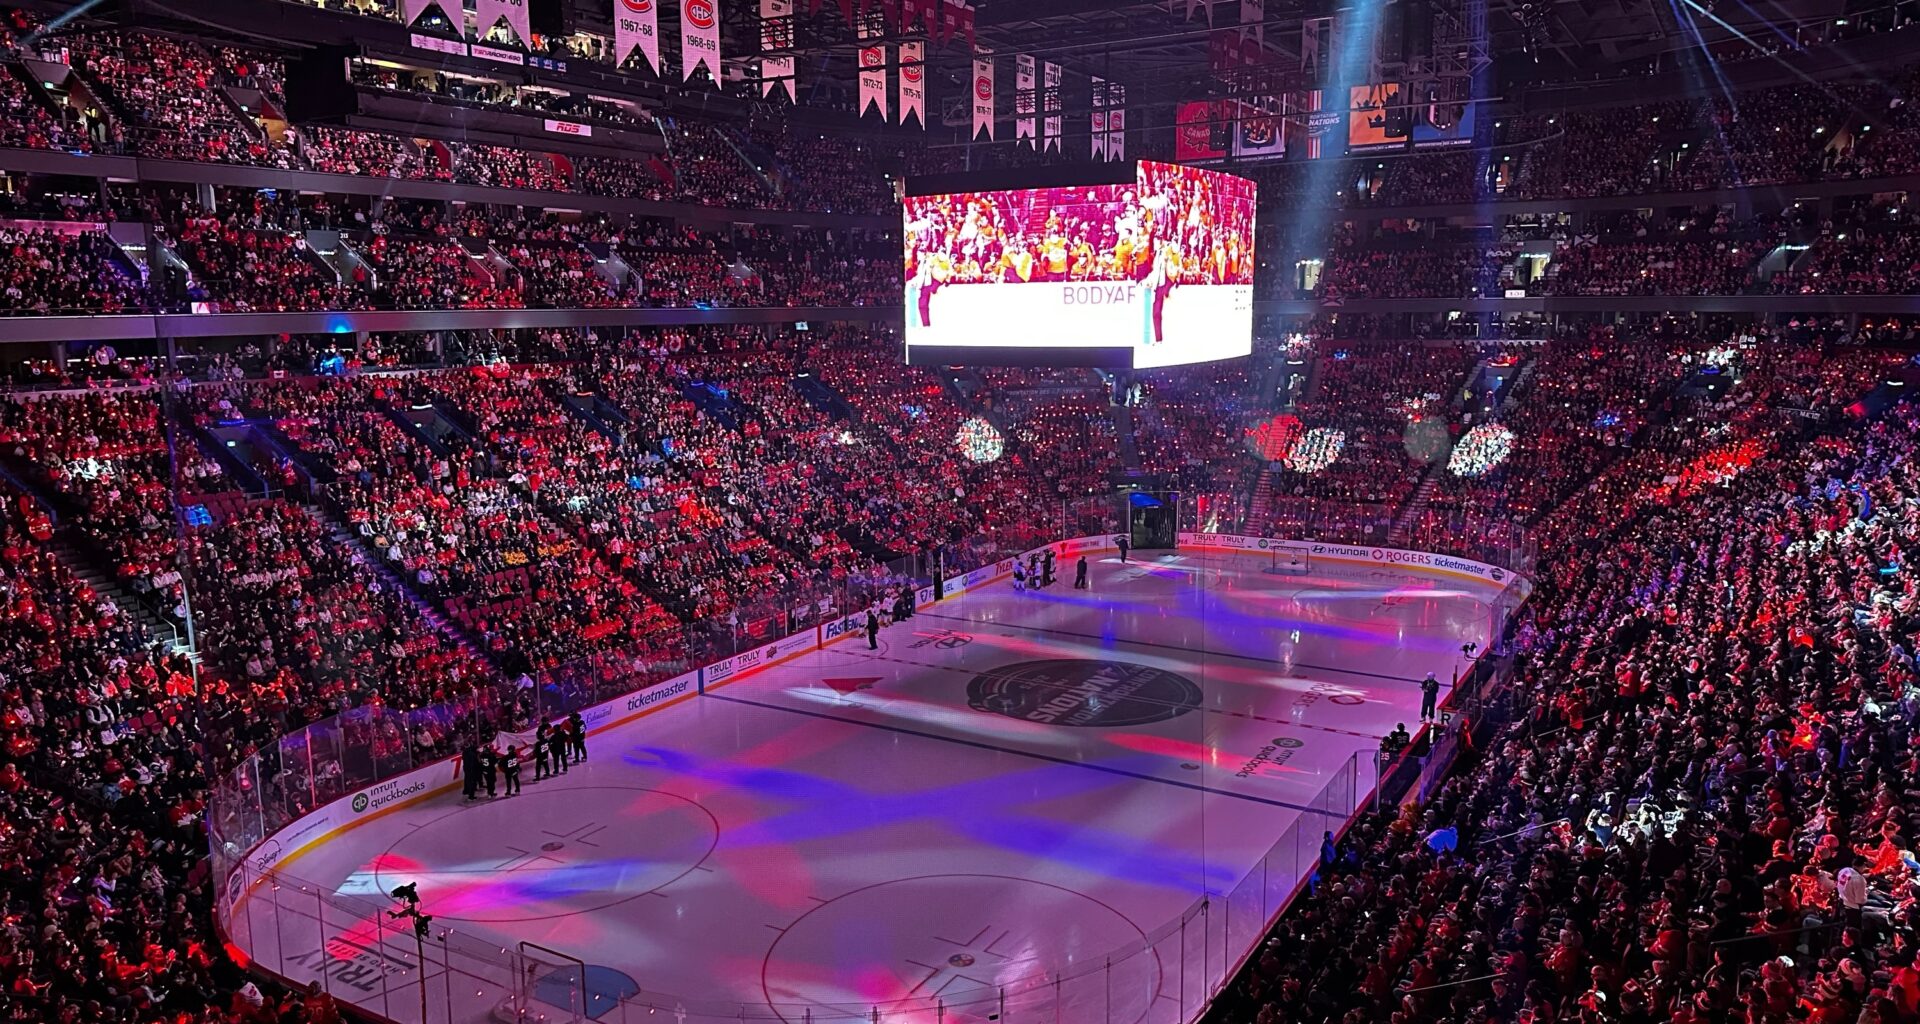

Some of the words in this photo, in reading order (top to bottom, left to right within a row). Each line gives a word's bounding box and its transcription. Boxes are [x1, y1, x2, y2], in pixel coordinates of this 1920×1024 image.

[620, 18, 653, 36] 1967-68
[686, 34, 716, 51] 1968-69
[862, 78, 883, 90] 1972-73
[902, 87, 921, 99] 1975-76
[1308, 116, 1340, 126] NATIONS
[556, 122, 580, 134] RDS
[1187, 127, 1210, 138] CANAD
[1193, 534, 1217, 542] TRULY
[1222, 536, 1246, 544] TRULY
[1328, 546, 1368, 557] HYUNDAI
[1386, 551, 1432, 564] ROGERS
[1434, 557, 1486, 575] ticketmaster
[737, 650, 760, 664] TRULY
[708, 660, 733, 675] TRULY
[627, 680, 689, 711] ticketmaster
[1024, 674, 1121, 723] NATIONS
[540, 742, 549, 752] 25
[508, 758, 518, 768] 25
[370, 780, 398, 796] INTUIT
[371, 782, 426, 808] quickbooks
[285, 949, 388, 992] TRULY
